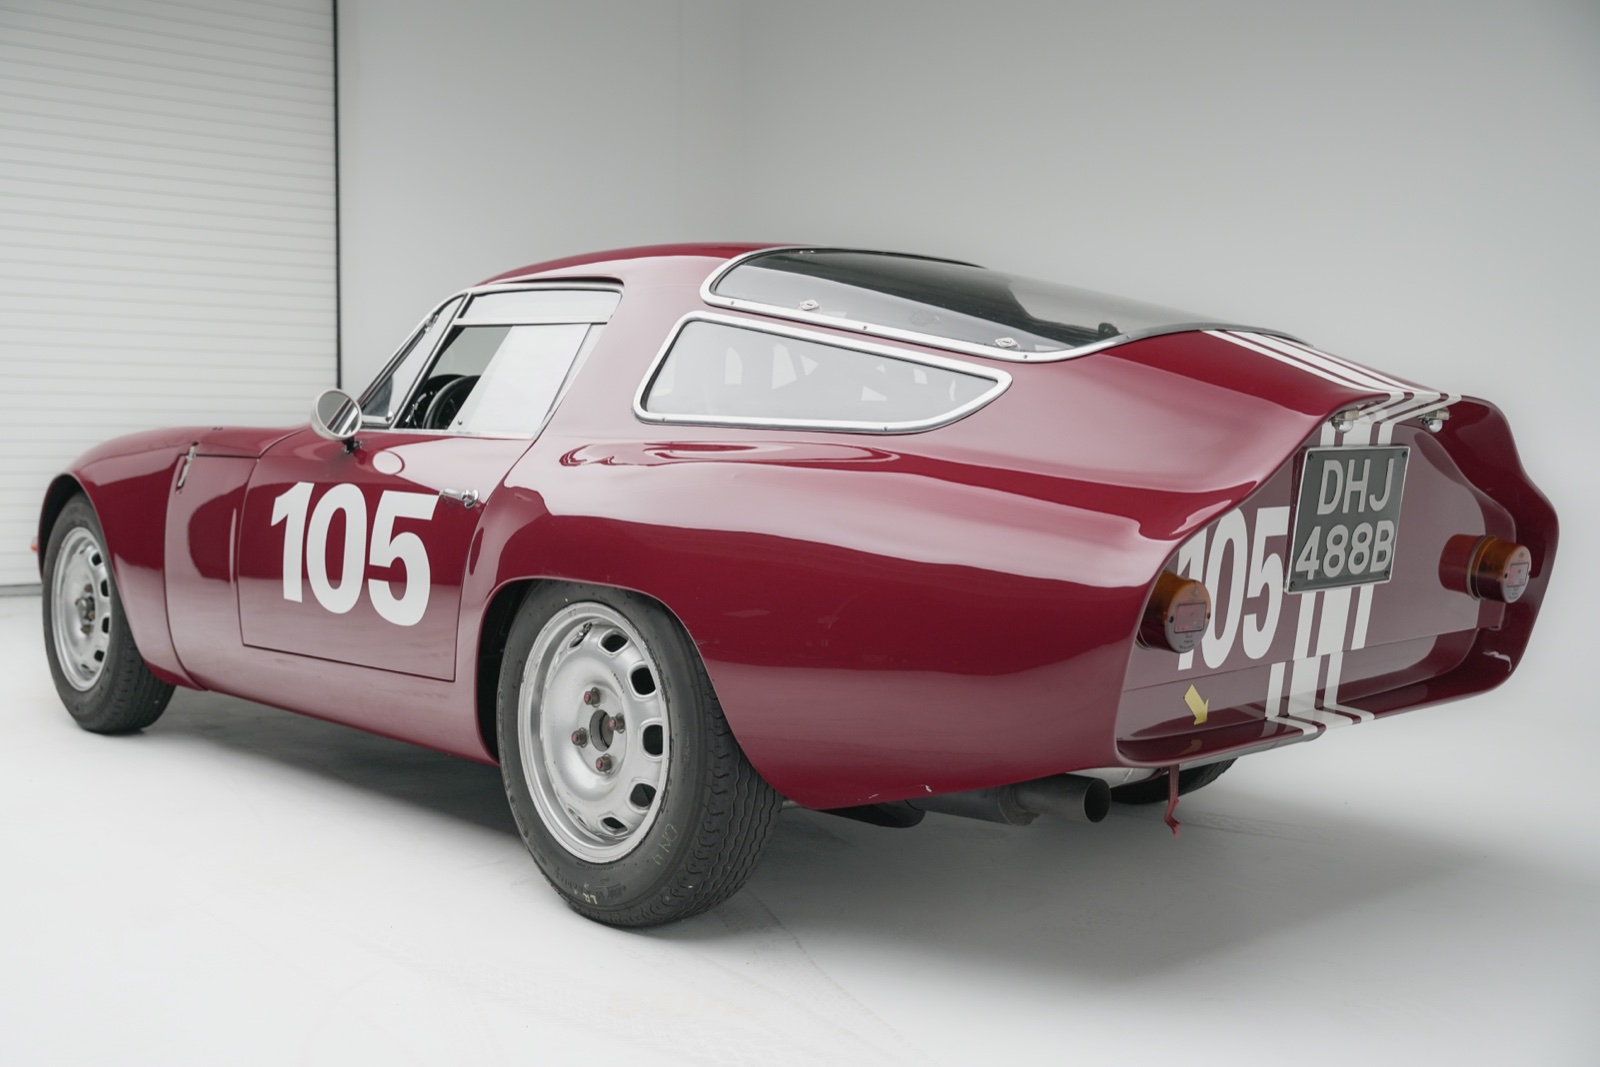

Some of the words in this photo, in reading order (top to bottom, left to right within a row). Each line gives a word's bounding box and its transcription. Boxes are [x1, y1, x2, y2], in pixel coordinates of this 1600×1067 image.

[1317, 458, 1394, 515] DHJ
[270, 481, 440, 627] 105
[1295, 520, 1395, 580] 488B
